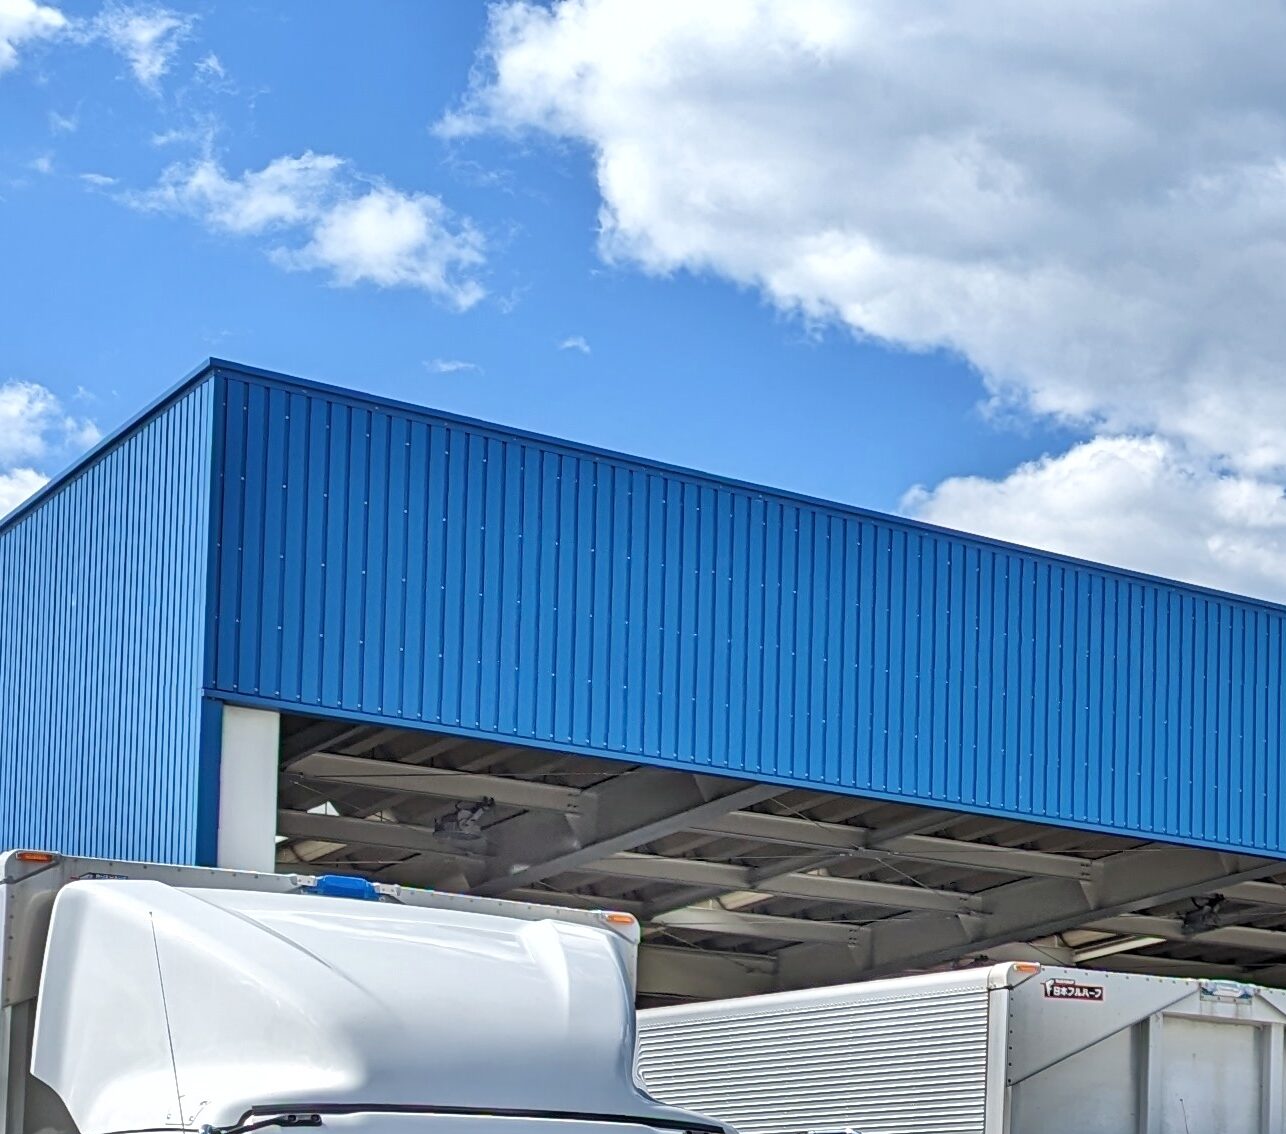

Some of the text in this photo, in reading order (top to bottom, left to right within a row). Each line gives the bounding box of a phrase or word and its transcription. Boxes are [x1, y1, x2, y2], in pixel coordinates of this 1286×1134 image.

[1053, 985, 1102, 998] 日本フルハーフ
